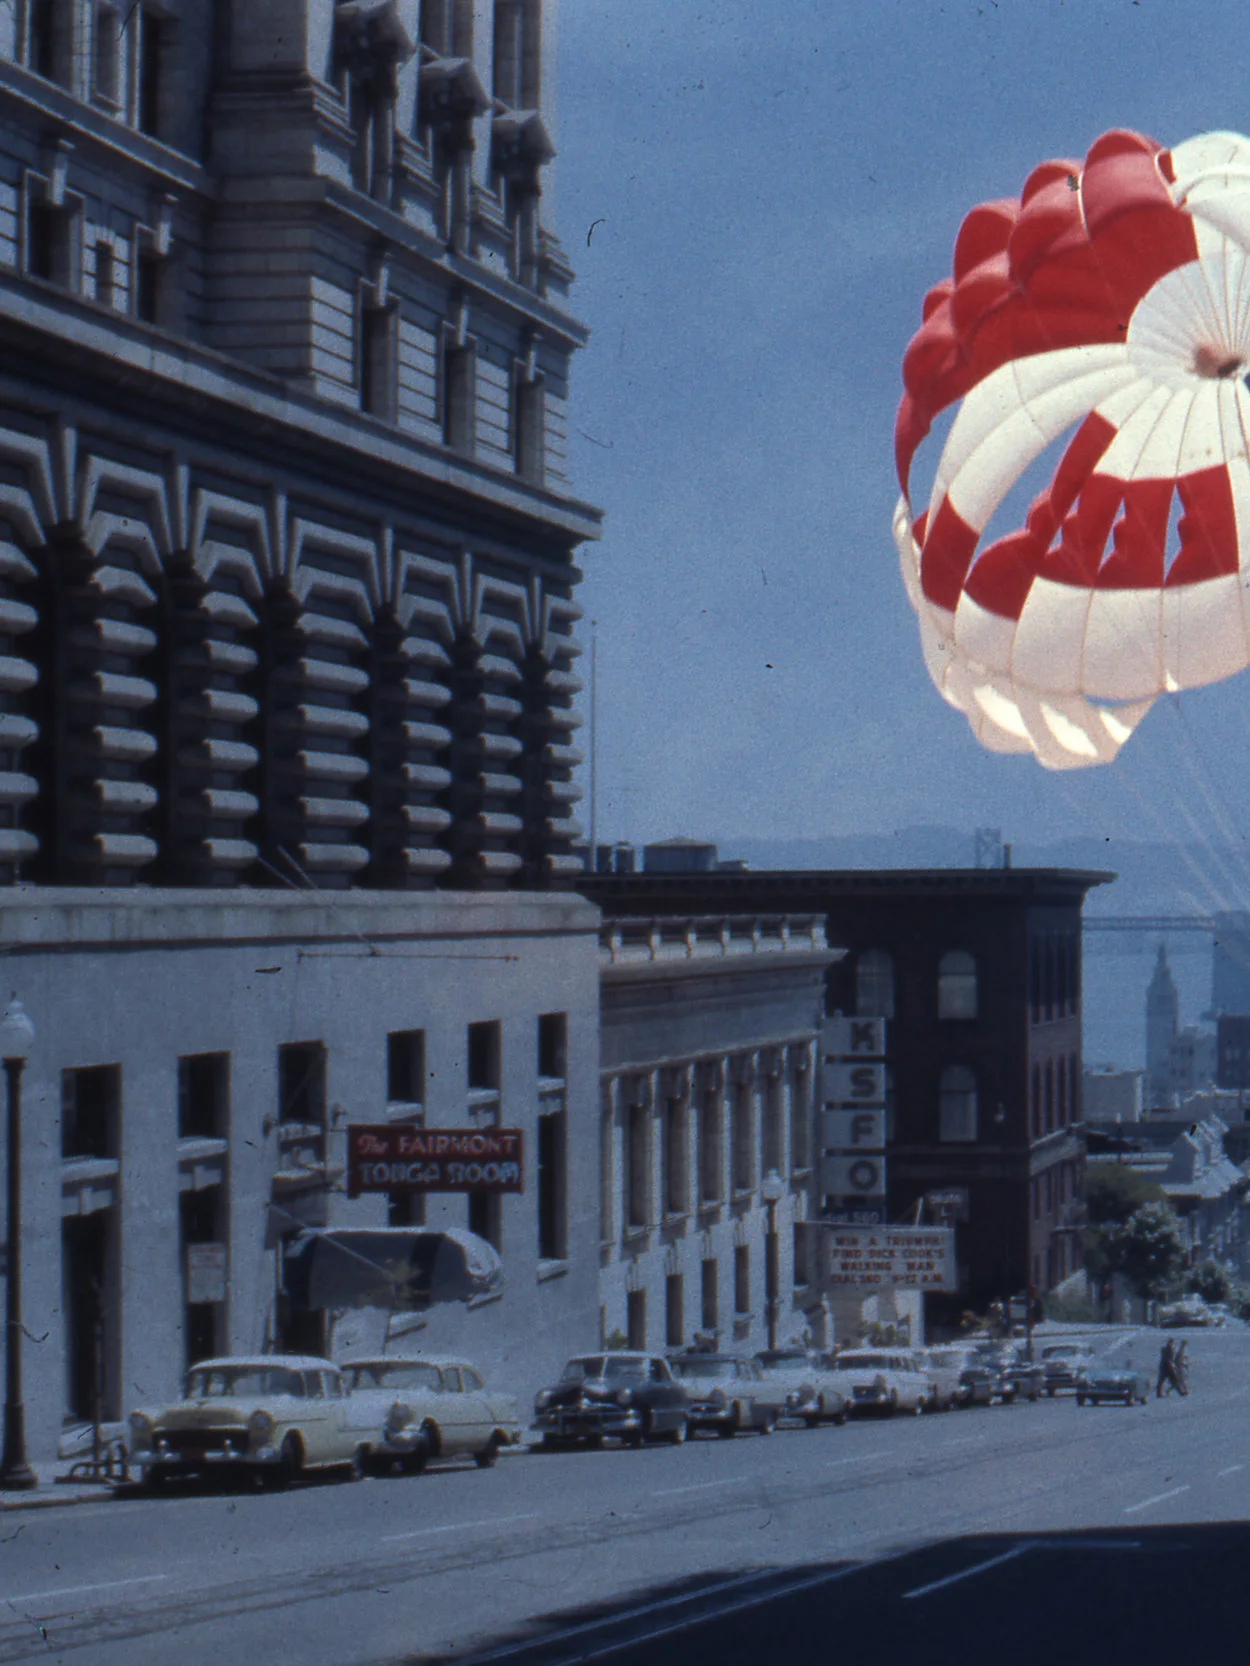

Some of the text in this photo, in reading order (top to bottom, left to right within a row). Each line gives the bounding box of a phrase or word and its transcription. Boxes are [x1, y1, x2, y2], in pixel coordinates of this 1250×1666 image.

[849, 1021, 879, 1191] KSFO
[357, 1134, 518, 1154] The FAIRMONT
[358, 1161, 521, 1185] TONGA ROOM
[840, 1261, 936, 1271] WALKING MAN
